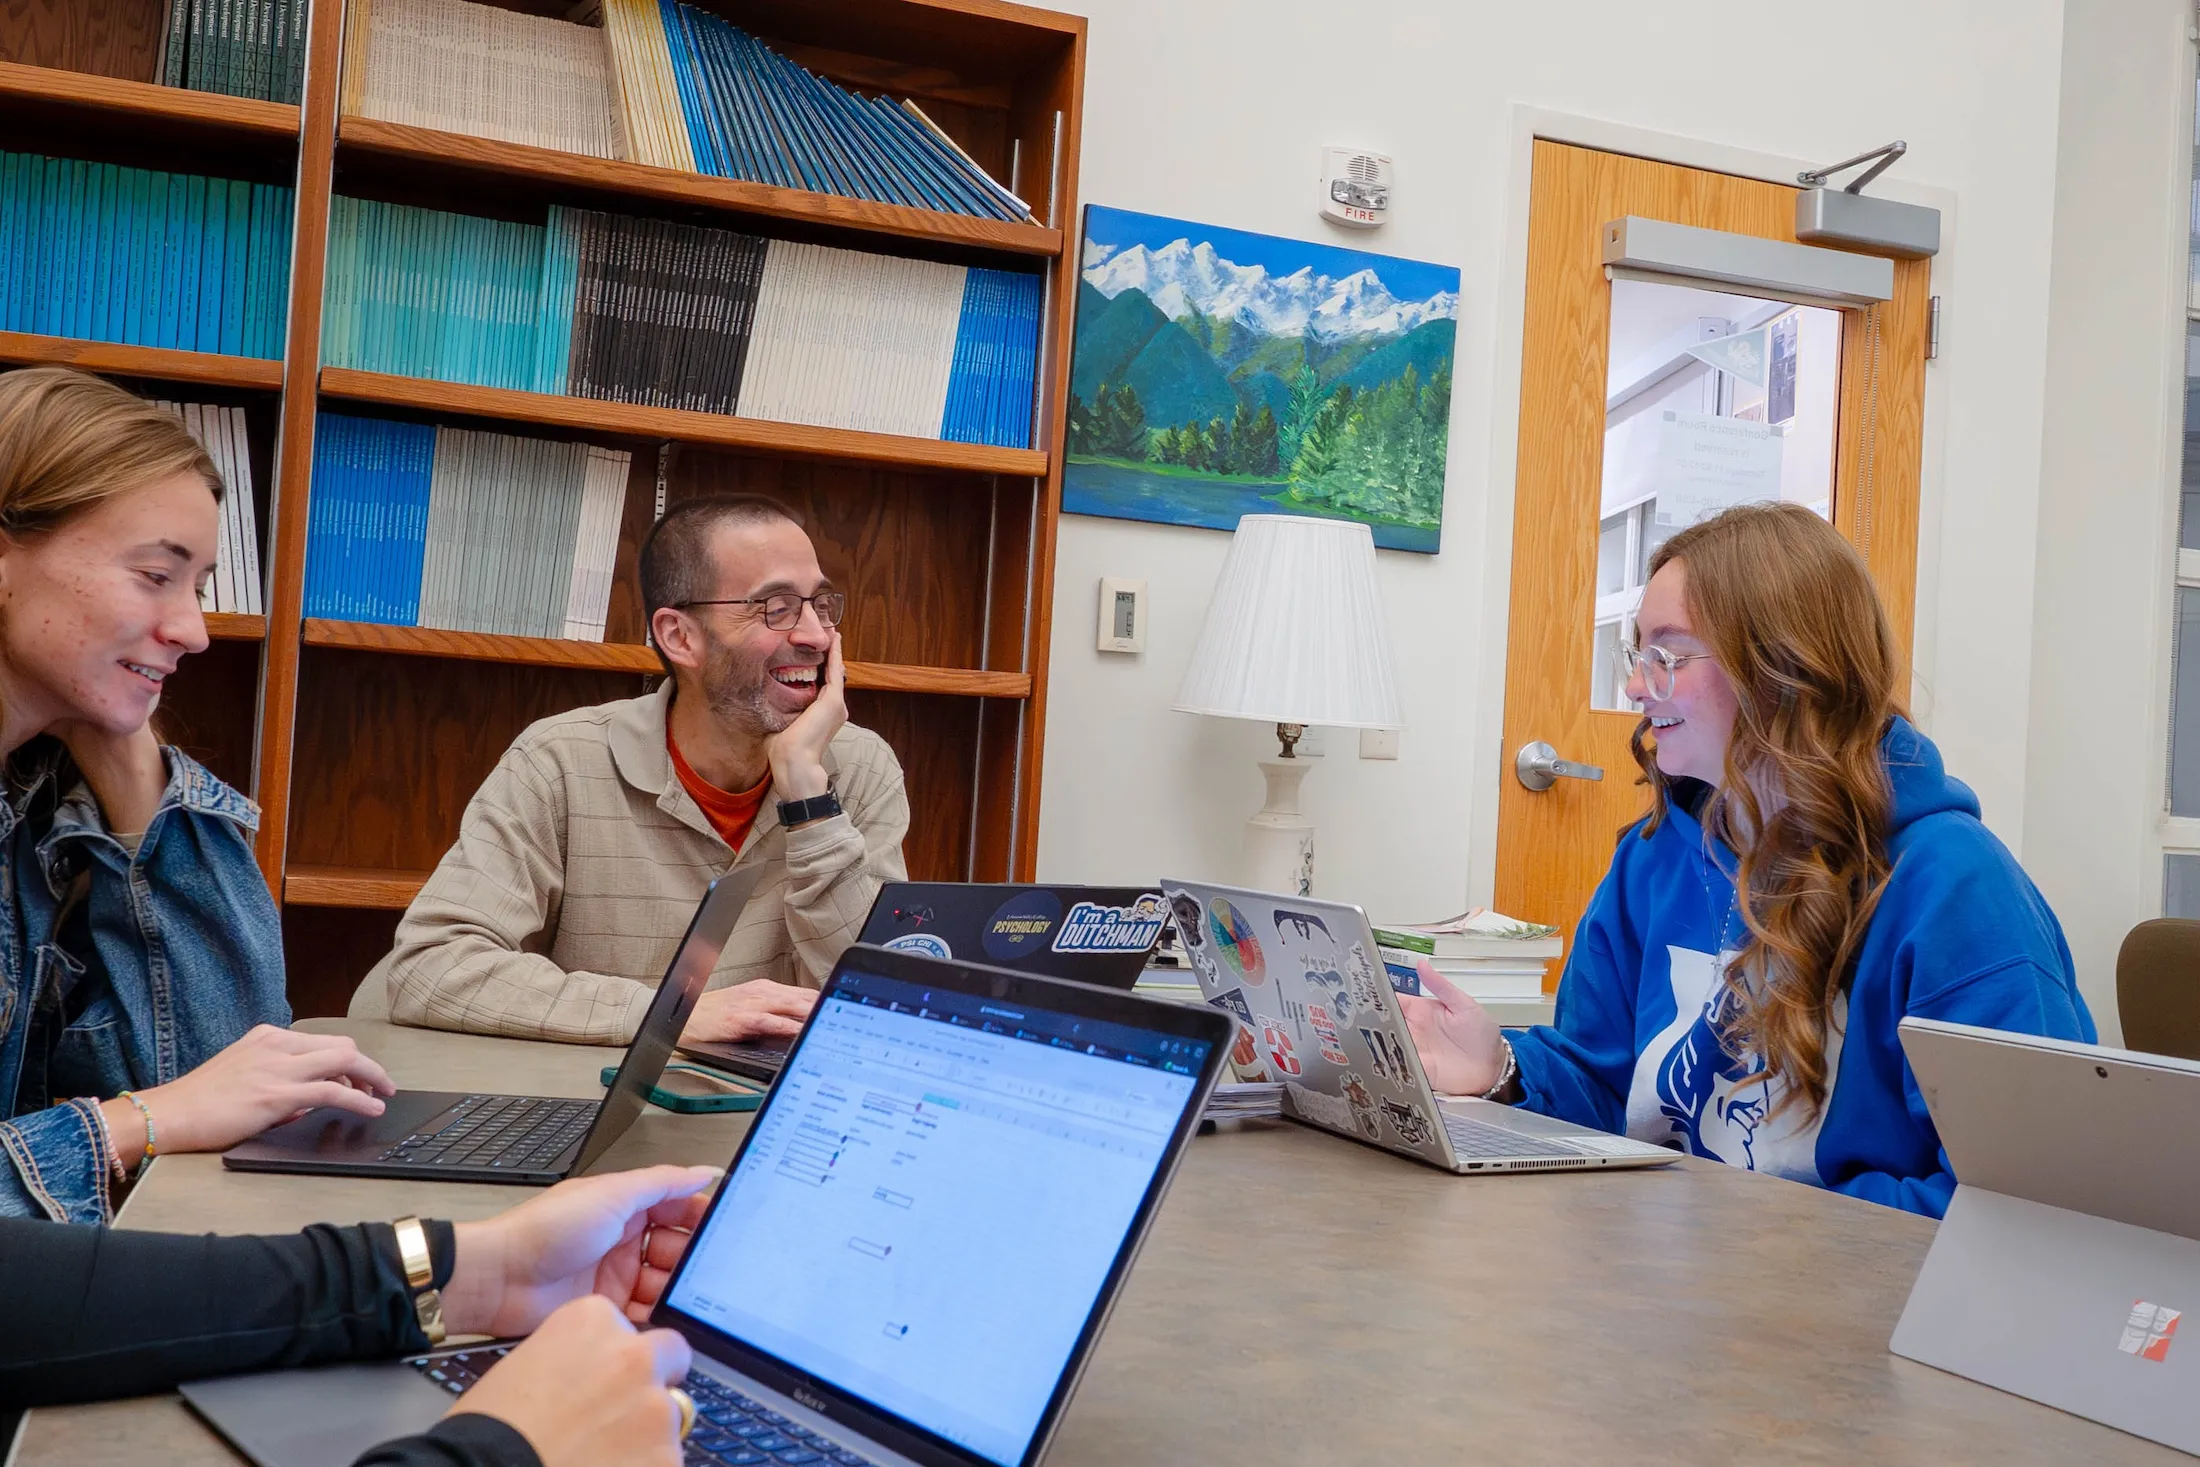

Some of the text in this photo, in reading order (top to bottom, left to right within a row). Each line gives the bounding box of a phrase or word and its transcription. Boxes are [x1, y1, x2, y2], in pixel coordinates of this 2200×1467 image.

[208, 0, 217, 36] evelopment
[221, 0, 230, 38] evelopment
[247, 0, 258, 43] Development
[261, 2, 271, 45] Development
[277, 4, 287, 48] Development
[1345, 207, 1375, 221] FIRE
[992, 920, 1052, 934] PSYCHOLOGY
[1072, 909, 1117, 924] I'm a
[901, 939, 933, 949] PSI CHI
[1060, 923, 1158, 947] DUTCHMAN
